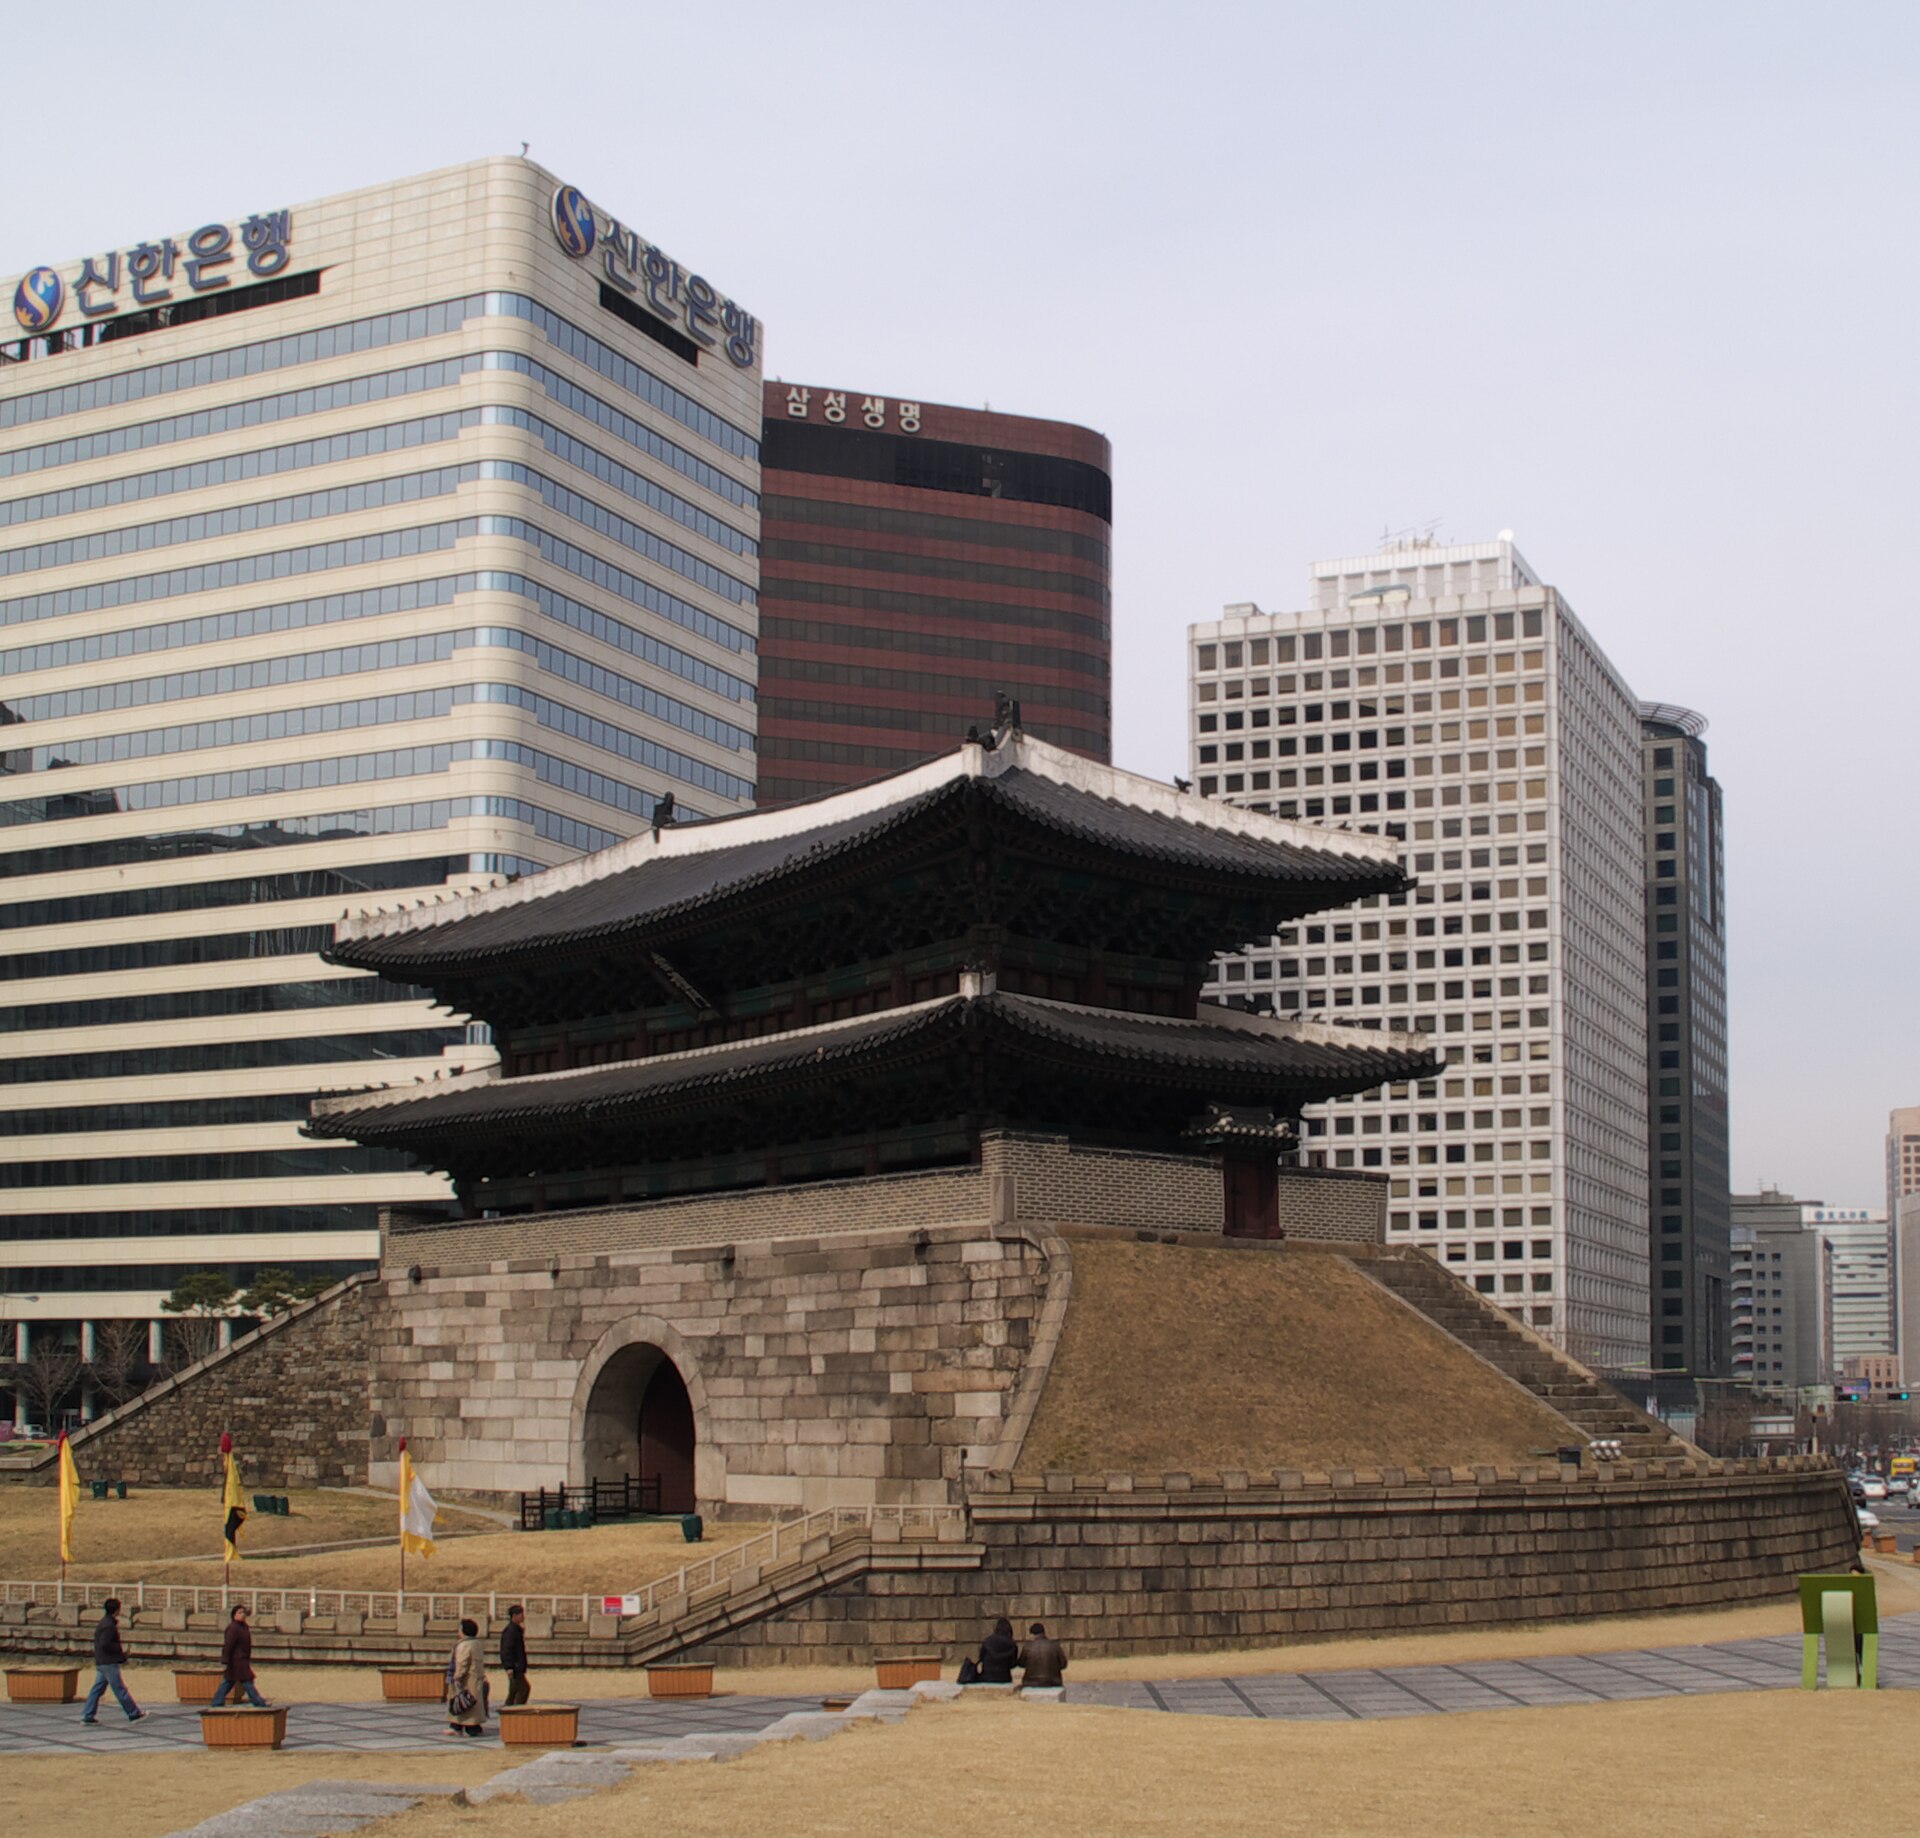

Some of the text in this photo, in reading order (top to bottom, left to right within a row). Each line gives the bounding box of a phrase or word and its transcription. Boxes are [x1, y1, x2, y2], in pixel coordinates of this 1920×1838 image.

[71, 208, 293, 317] 신한은행
[599, 216, 756, 369] 신한은행
[786, 386, 921, 433] 삼성생명
